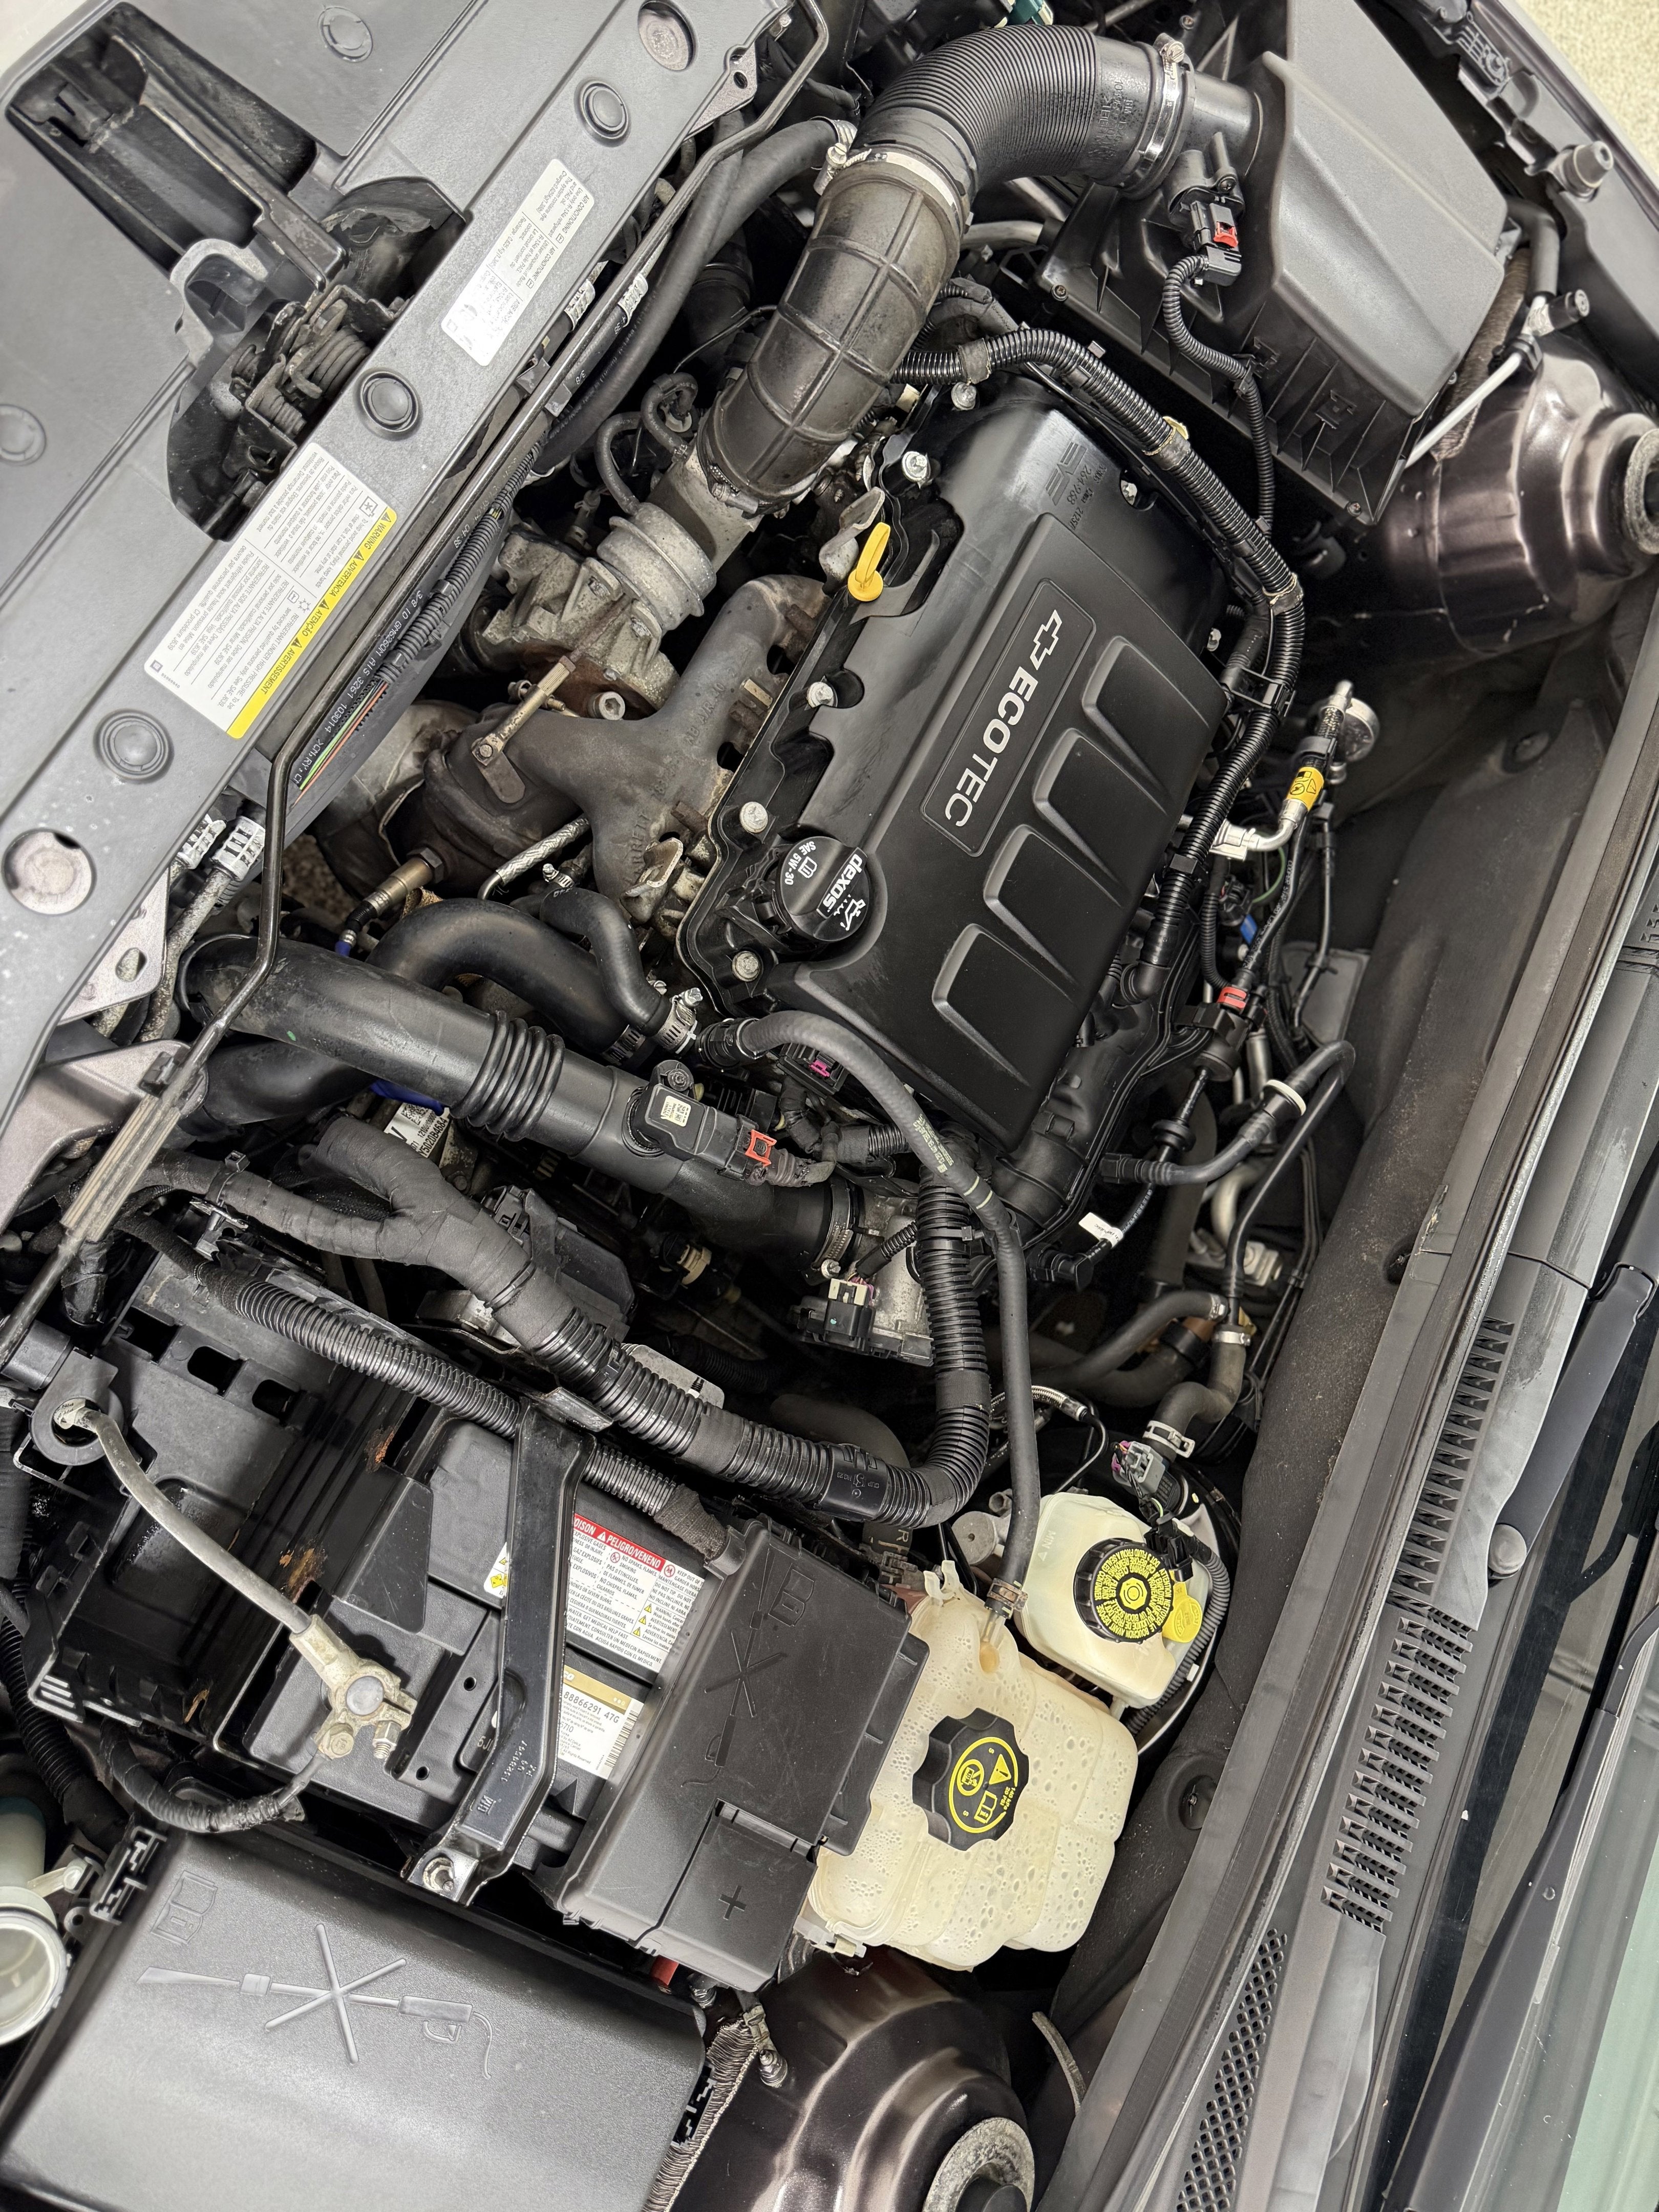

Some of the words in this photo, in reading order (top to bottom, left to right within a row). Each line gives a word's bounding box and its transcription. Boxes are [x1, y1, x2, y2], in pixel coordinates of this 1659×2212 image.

[562, 202, 584, 233] CONDITIONING
[573, 369, 587, 386] 3/8
[364, 523, 386, 549] WARNING
[241, 551, 254, 565] Fluide
[248, 559, 262, 577] somente
[211, 567, 229, 591] personnel
[244, 563, 269, 594] REFRIGERANTE
[329, 560, 357, 596] ADVERTENCIA
[216, 587, 226, 599] sous
[238, 593, 247, 603] SOB
[254, 589, 269, 610] personal
[264, 580, 289, 612] REFRIGERANTE
[409, 589, 424, 608] 3/8
[207, 598, 219, 611] haute
[230, 602, 240, 613] ALTA
[253, 614, 263, 625] ALTA
[276, 607, 291, 626] serviced
[302, 609, 322, 636] ATENÇÃO
[183, 631, 194, 643] Mise
[206, 624, 216, 633] Veja
[275, 613, 299, 645] REFRIGERANT
[167, 637, 178, 650] J639
[198, 634, 207, 644] SAE
[207, 633, 218, 644] Deve
[229, 631, 240, 644] Mirar
[259, 631, 273, 650] qualified
[190, 643, 200, 655] J639
[222, 643, 231, 654] SAE
[231, 644, 242, 656] Debe
[247, 648, 261, 666] persons
[263, 643, 277, 660] UNDER
[184, 651, 203, 676] manipulado
[214, 652, 224, 665] J639
[254, 659, 265, 672] HIGH
[208, 663, 227, 688] manipulado
[261, 648, 294, 694] AVERTISSEMENT
[233, 676, 242, 685] See
[346, 675, 366, 700] 3261
[226, 685, 236, 695] SAE
[323, 701, 349, 734] 103014
[945, 666, 1037, 826] ECOTEC
[799, 841, 815, 859] SAE
[780, 853, 806, 884] 5W-30
[605, 1533, 662, 1570] PELIGRO/VENENO
[620, 1562, 636, 1573] SMOKING
[674, 1576, 689, 1586] GARDER
[591, 1619, 607, 1629] MEDICAL
[591, 1626, 613, 1640] CONSULTER
[595, 1636, 608, 1645] ACUDA
[564, 1692, 601, 1714] 88866291
[604, 1712, 619, 1722] 47G
[1004, 1786, 1010, 1795] 20
